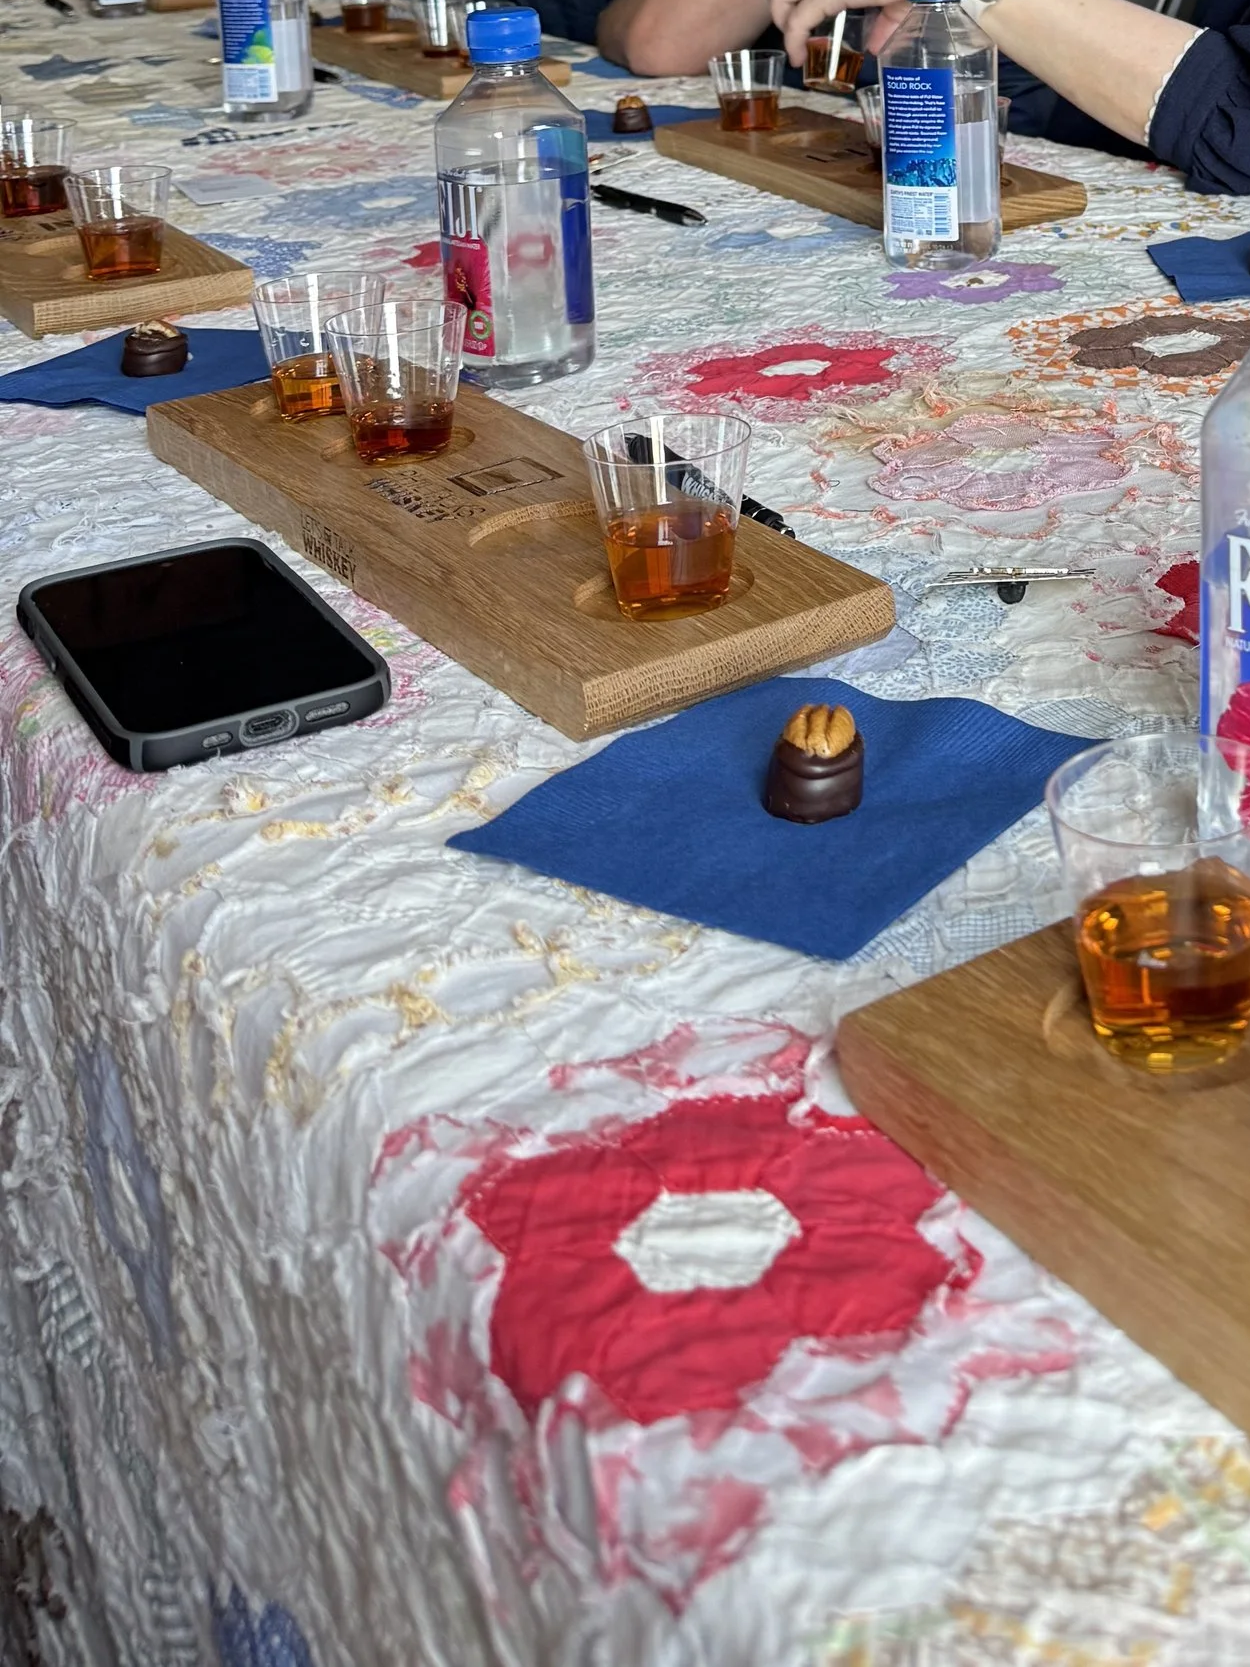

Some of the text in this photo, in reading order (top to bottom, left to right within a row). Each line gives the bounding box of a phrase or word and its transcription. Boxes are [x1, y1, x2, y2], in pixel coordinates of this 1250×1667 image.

[887, 81, 932, 90] SOLID ROCK
[303, 530, 356, 583] WHISKEY
